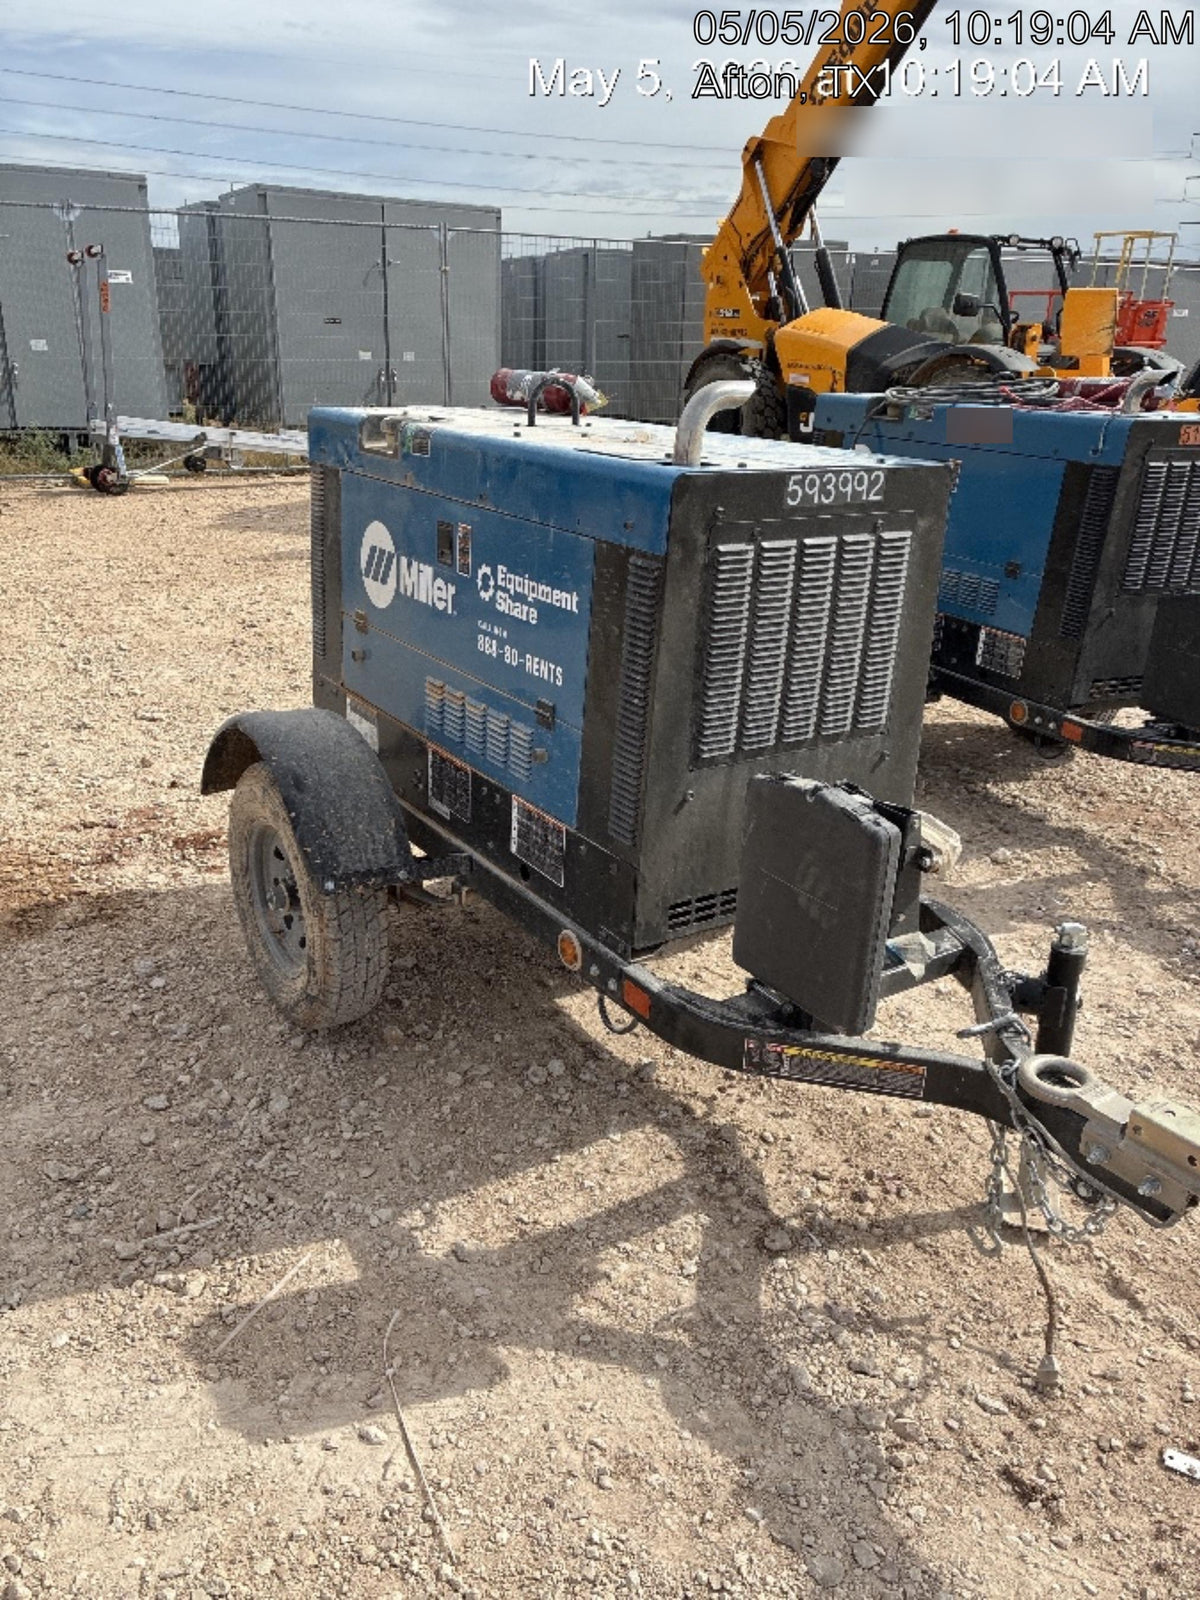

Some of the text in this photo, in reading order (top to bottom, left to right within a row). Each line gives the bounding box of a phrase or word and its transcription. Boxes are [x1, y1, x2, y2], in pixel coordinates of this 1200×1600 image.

[786, 470, 885, 506] 593992
[399, 556, 457, 614] Miller
[496, 565, 579, 614] Equipment
[495, 590, 538, 625] Share
